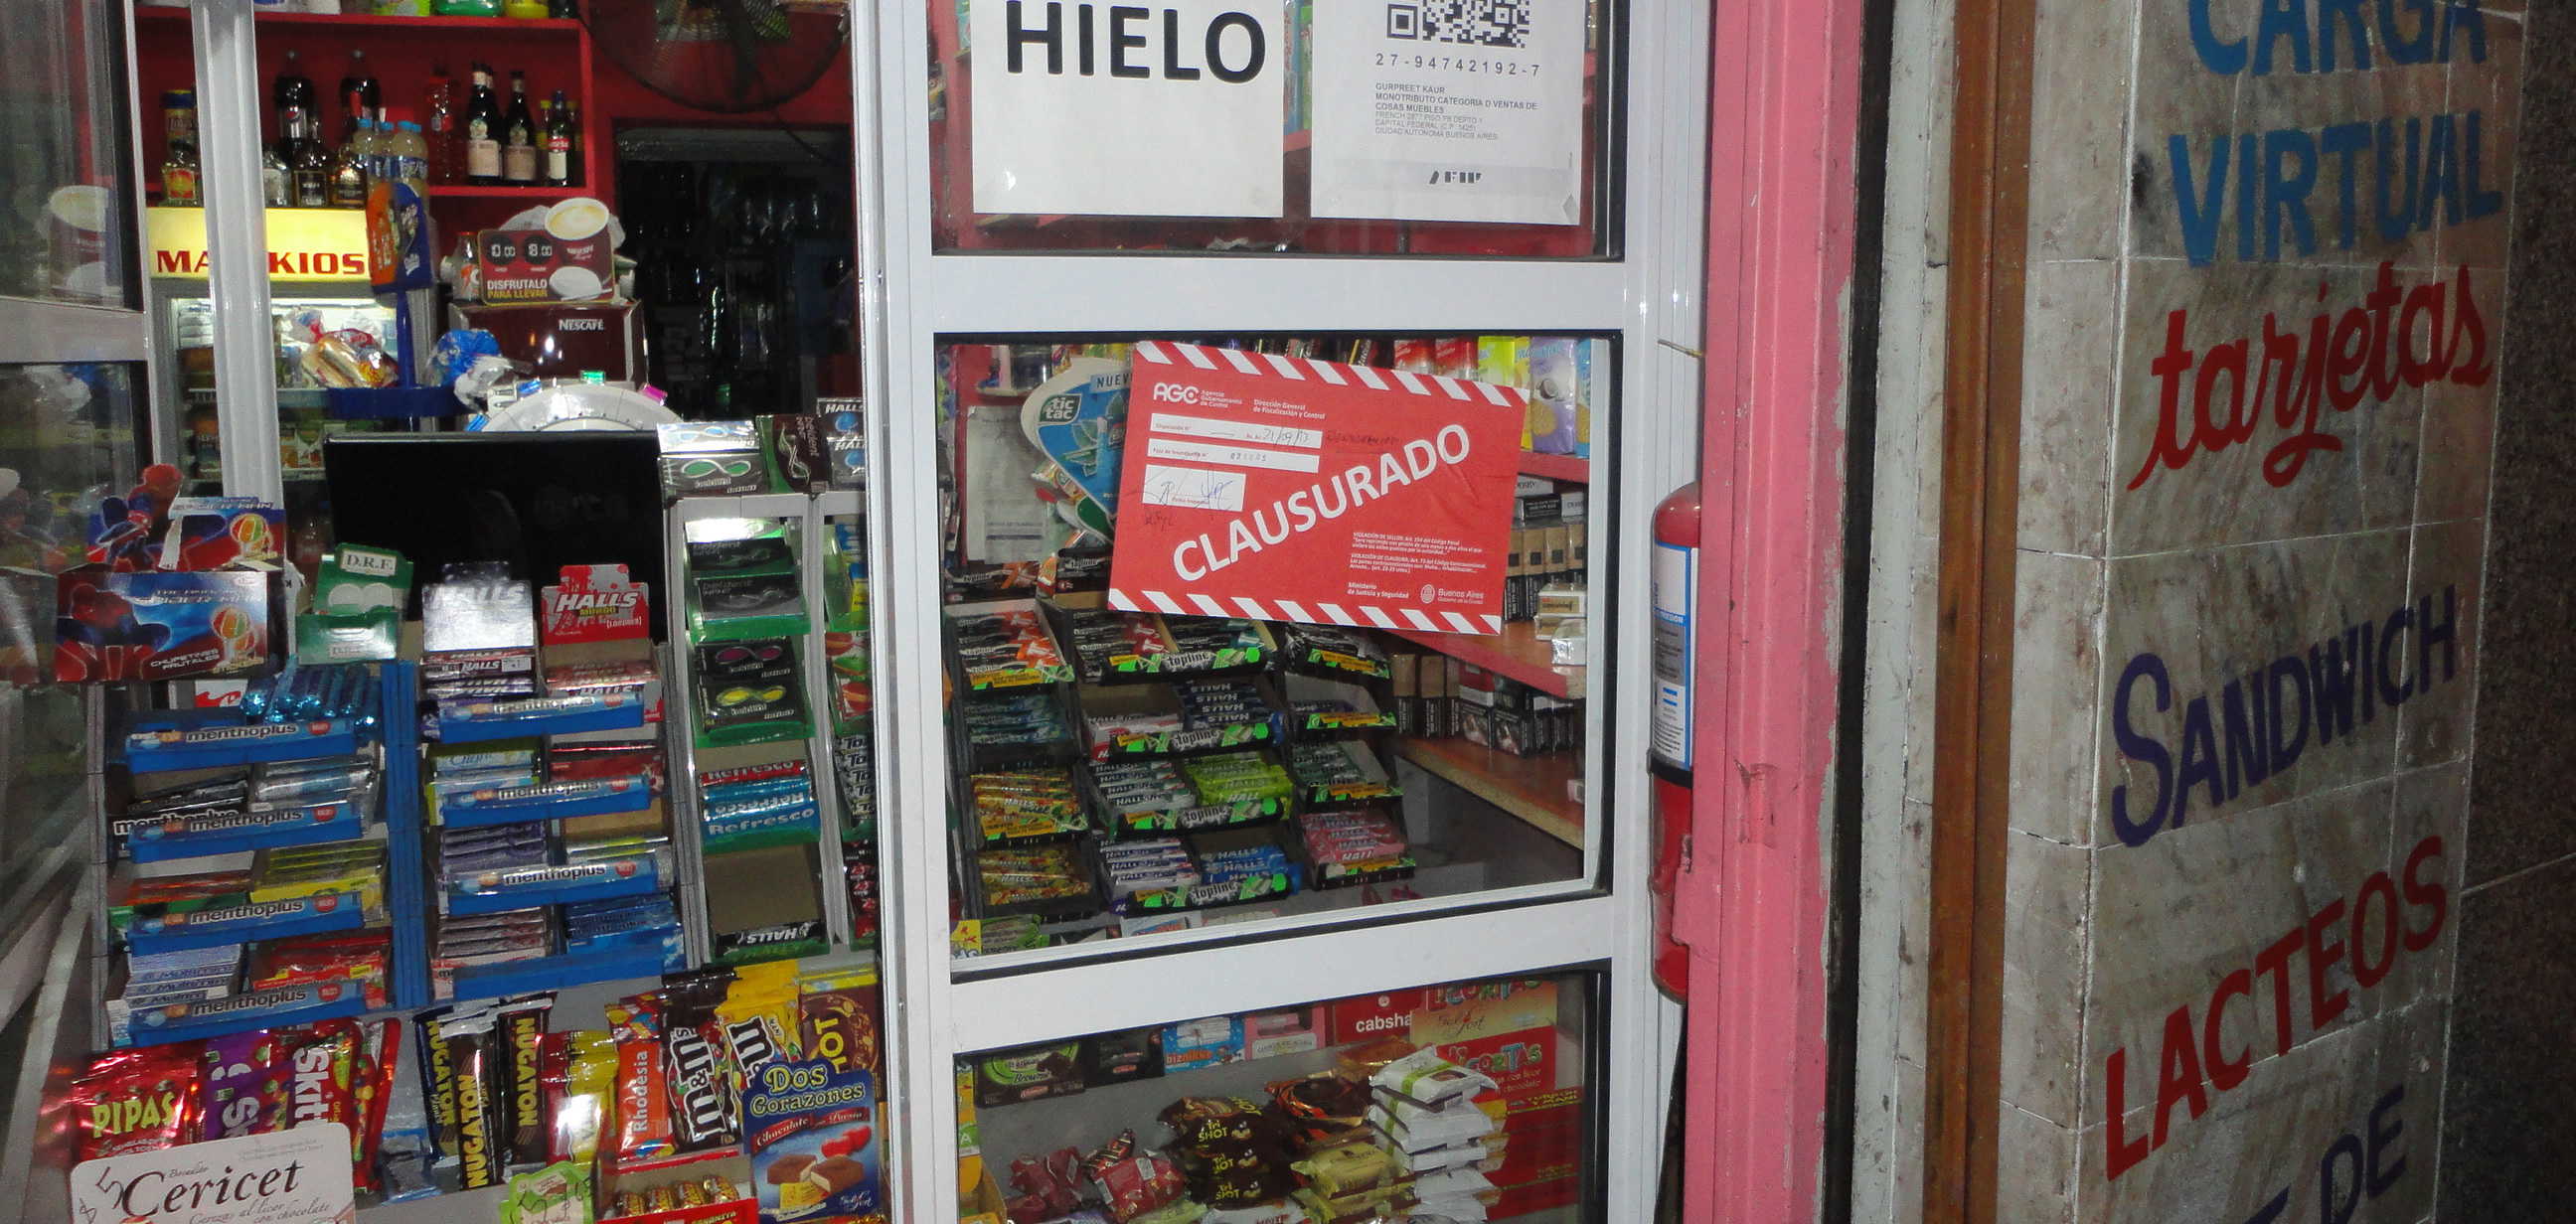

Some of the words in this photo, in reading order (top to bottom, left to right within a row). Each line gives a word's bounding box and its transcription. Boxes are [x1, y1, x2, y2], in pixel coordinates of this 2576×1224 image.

[1006, 0, 1265, 83] HIELO
[2188, 0, 2486, 76] CARGA
[1375, 82, 1421, 93] GURPREET
[1422, 84, 1445, 94] KAUR
[1375, 92, 1436, 104] MONOTRIBUTO
[1437, 95, 1484, 107] CATEGORIA
[1493, 99, 1525, 109] VENTAS
[1375, 102, 1404, 112] COSAS
[1406, 104, 1444, 114] MUEBLES
[1375, 111, 1405, 120] FRENCH
[1424, 113, 1441, 122] PISO
[1453, 115, 1478, 124] DEPTO
[1375, 119, 1405, 128] CAPITAL
[1407, 120, 1439, 130] FEDERAL
[1375, 127, 1403, 136] CIUDAD
[1404, 128, 1444, 138] AUTONOMA
[1445, 130, 1475, 139] BUENOS
[1477, 131, 1498, 141] AIRES
[2169, 109, 2502, 267] VIRTUAL
[487, 279, 547, 290] DISFRUTALO
[559, 318, 604, 331] NESCAFÉ
[2127, 260, 2493, 491] tarjetas
[1051, 397, 1074, 409] tic
[1153, 382, 1200, 404] AGC
[1046, 407, 1074, 419] tac
[1253, 399, 1281, 409] Dirección
[1282, 402, 1305, 411] General
[1261, 406, 1297, 417] Fiscalización
[1304, 410, 1326, 419] Control
[1173, 424, 1470, 581] CLAUSURADO
[557, 592, 638, 612] HALLS
[1438, 588, 1465, 598] Buenos
[1467, 590, 1484, 599] Aires
[150, 648, 219, 668] CHUPETINES
[162, 655, 221, 671] FRUTALES
[461, 661, 501, 674] HALLS
[1169, 652, 1209, 667] topline
[2111, 583, 2457, 847] SANDWICH
[186, 723, 297, 742] menthoplus
[1176, 728, 1218, 745] topline
[499, 781, 601, 801] menthoplus
[716, 792, 805, 814] Refresco
[190, 809, 303, 833] menthoplus
[709, 808, 814, 835] Refresco
[1185, 806, 1227, 823] topline
[504, 864, 606, 885] menthoplus
[1196, 881, 1235, 899] topline
[191, 899, 303, 924] menthoplus
[746, 928, 796, 944] HALLS
[192, 988, 306, 1016] menthoplus
[2107, 836, 2446, 1180] LACTEOS
[1356, 1012, 1412, 1033] cabsha
[516, 1017, 538, 1127] NUGATON
[764, 1065, 828, 1094] Dos
[632, 1050, 648, 1134] Rhodesia
[751, 1084, 864, 1116] Corazones
[92, 1092, 176, 1139] PIPAS
[1207, 1119, 1220, 1130] Tri
[458, 1075, 488, 1188] NUGATON
[756, 1118, 809, 1147] Chocolate
[1199, 1127, 1228, 1143] SHOT
[2319, 1083, 2406, 1224] DE
[121, 1158, 304, 1218] Cericet
[277, 1197, 331, 1220] chocolate
